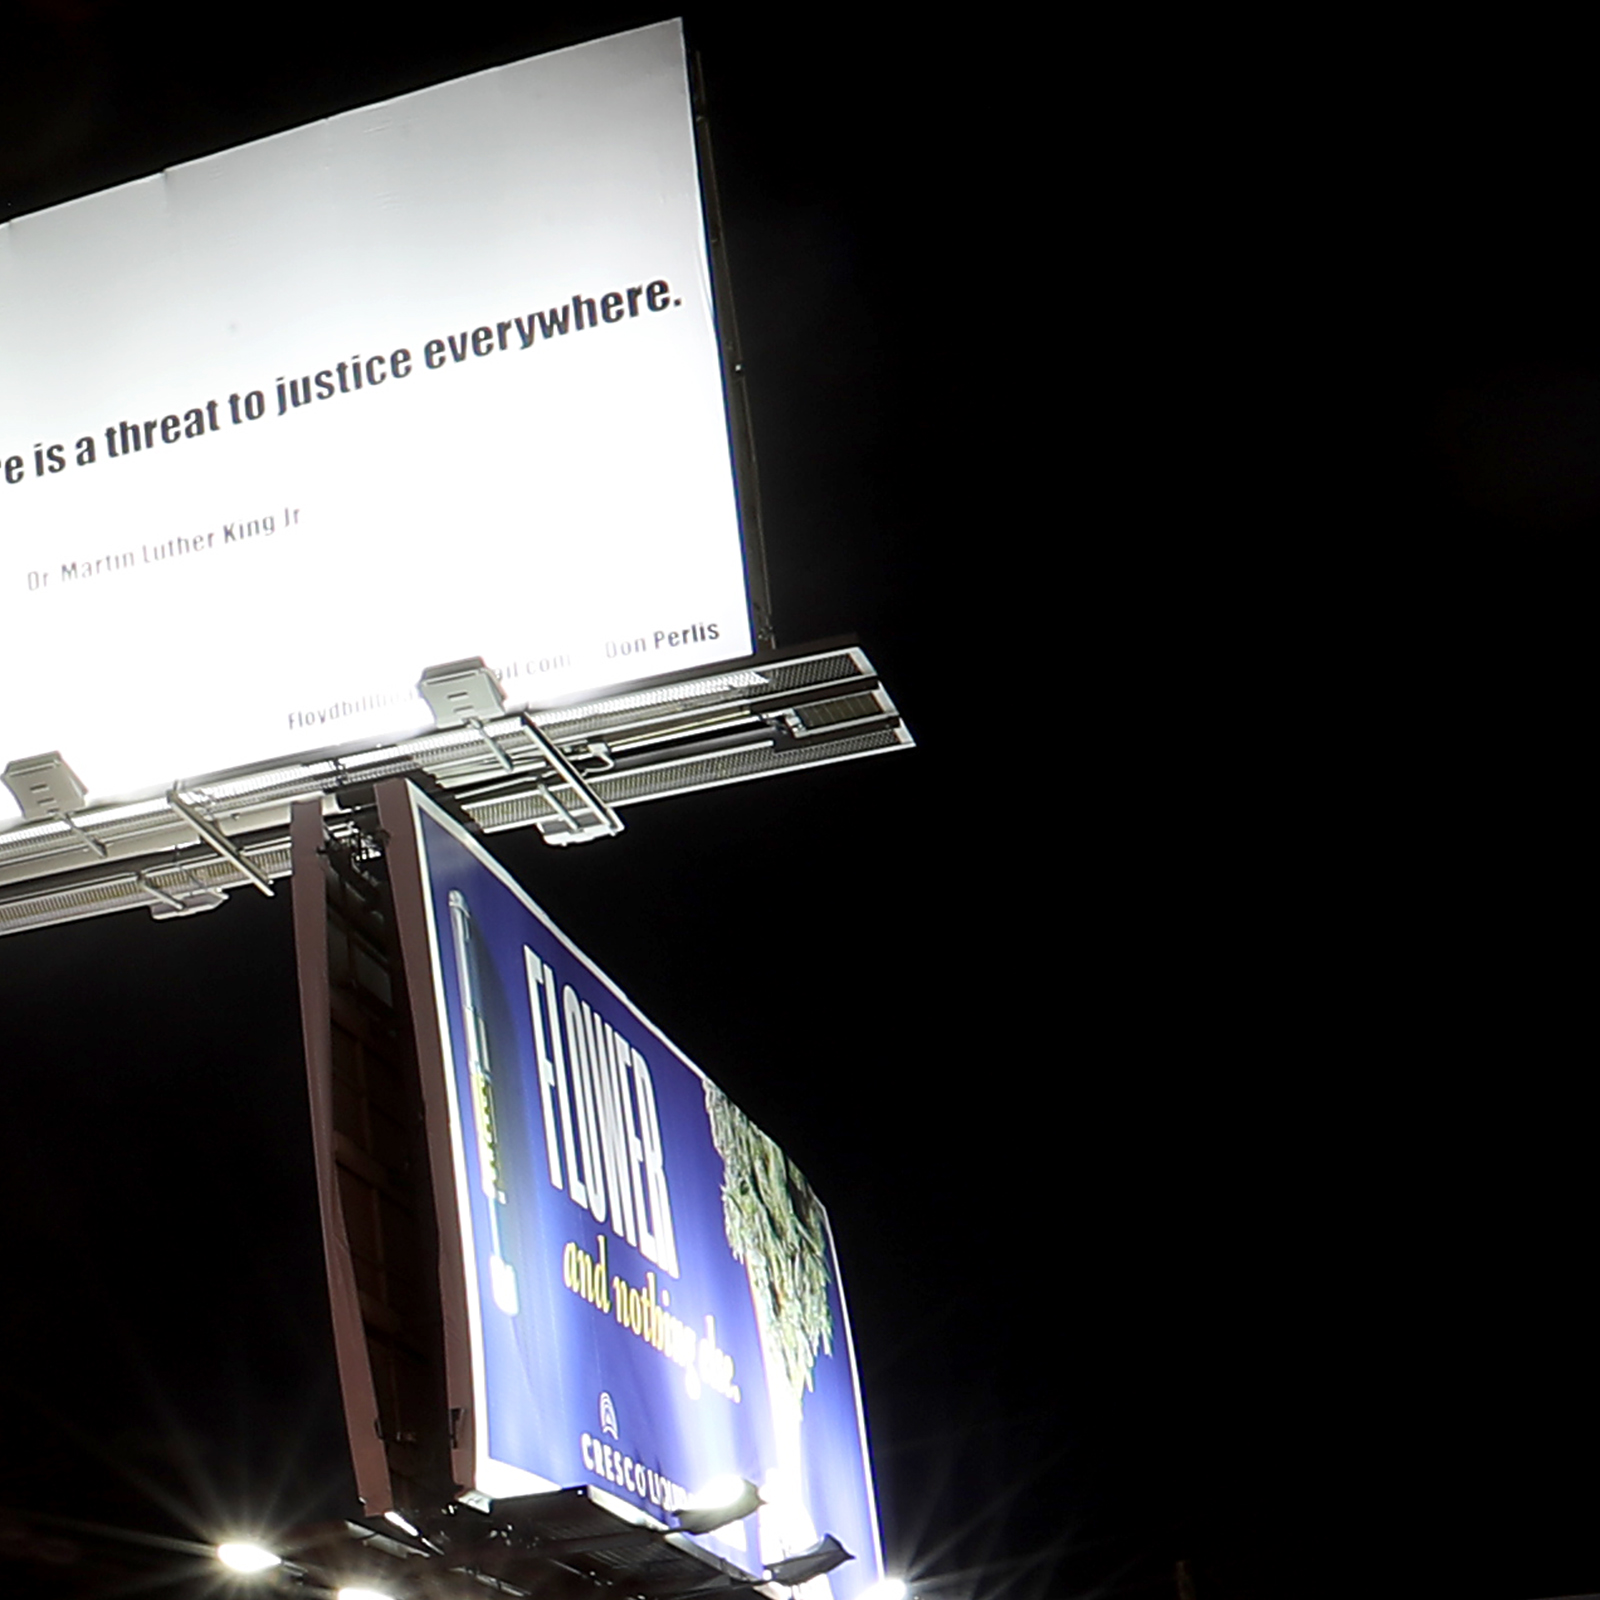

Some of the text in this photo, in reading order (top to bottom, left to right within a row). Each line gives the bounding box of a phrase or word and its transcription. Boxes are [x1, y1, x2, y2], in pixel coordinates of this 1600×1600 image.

[32, 441, 66, 477] is
[74, 436, 97, 466] a
[104, 398, 221, 458] threat
[227, 389, 266, 425] to
[274, 347, 413, 416] justice
[423, 278, 683, 370] everywhere.
[61, 551, 135, 582] Martin
[142, 531, 215, 564] Luther
[222, 514, 276, 544] King
[284, 506, 301, 528] Jr
[604, 637, 647, 659] Don
[653, 622, 721, 650] Perlis
[523, 944, 680, 1279] FLOWER
[564, 1234, 609, 1313] and
[581, 1433, 647, 1498] CRESCO
